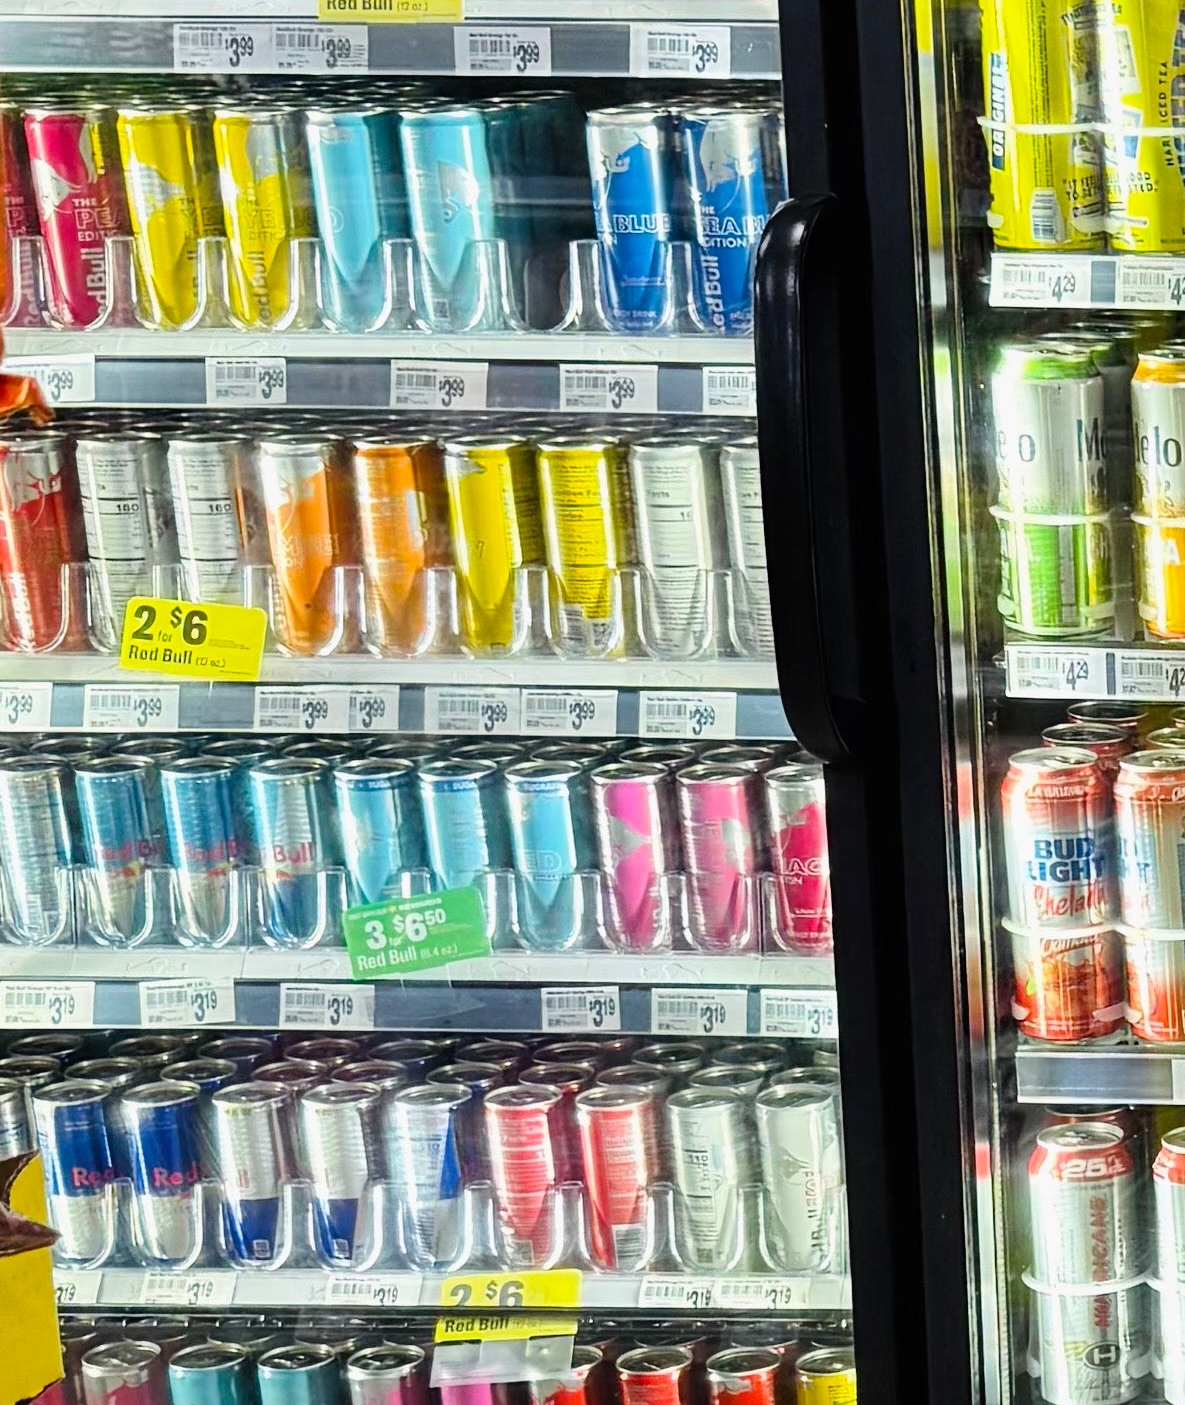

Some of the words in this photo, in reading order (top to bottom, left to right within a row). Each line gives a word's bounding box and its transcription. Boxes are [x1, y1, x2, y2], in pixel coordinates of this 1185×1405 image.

[131, 605, 156, 641] 2
[128, 645, 158, 661] Red
[162, 647, 192, 665] Bull
[1034, 836, 1095, 860] BUD
[1028, 855, 1105, 883] LIGHT
[364, 920, 387, 951] 3
[357, 953, 386, 971] Red
[389, 948, 417, 967] Bull
[445, 1319, 476, 1333] Red
[478, 1317, 511, 1332] Bull
